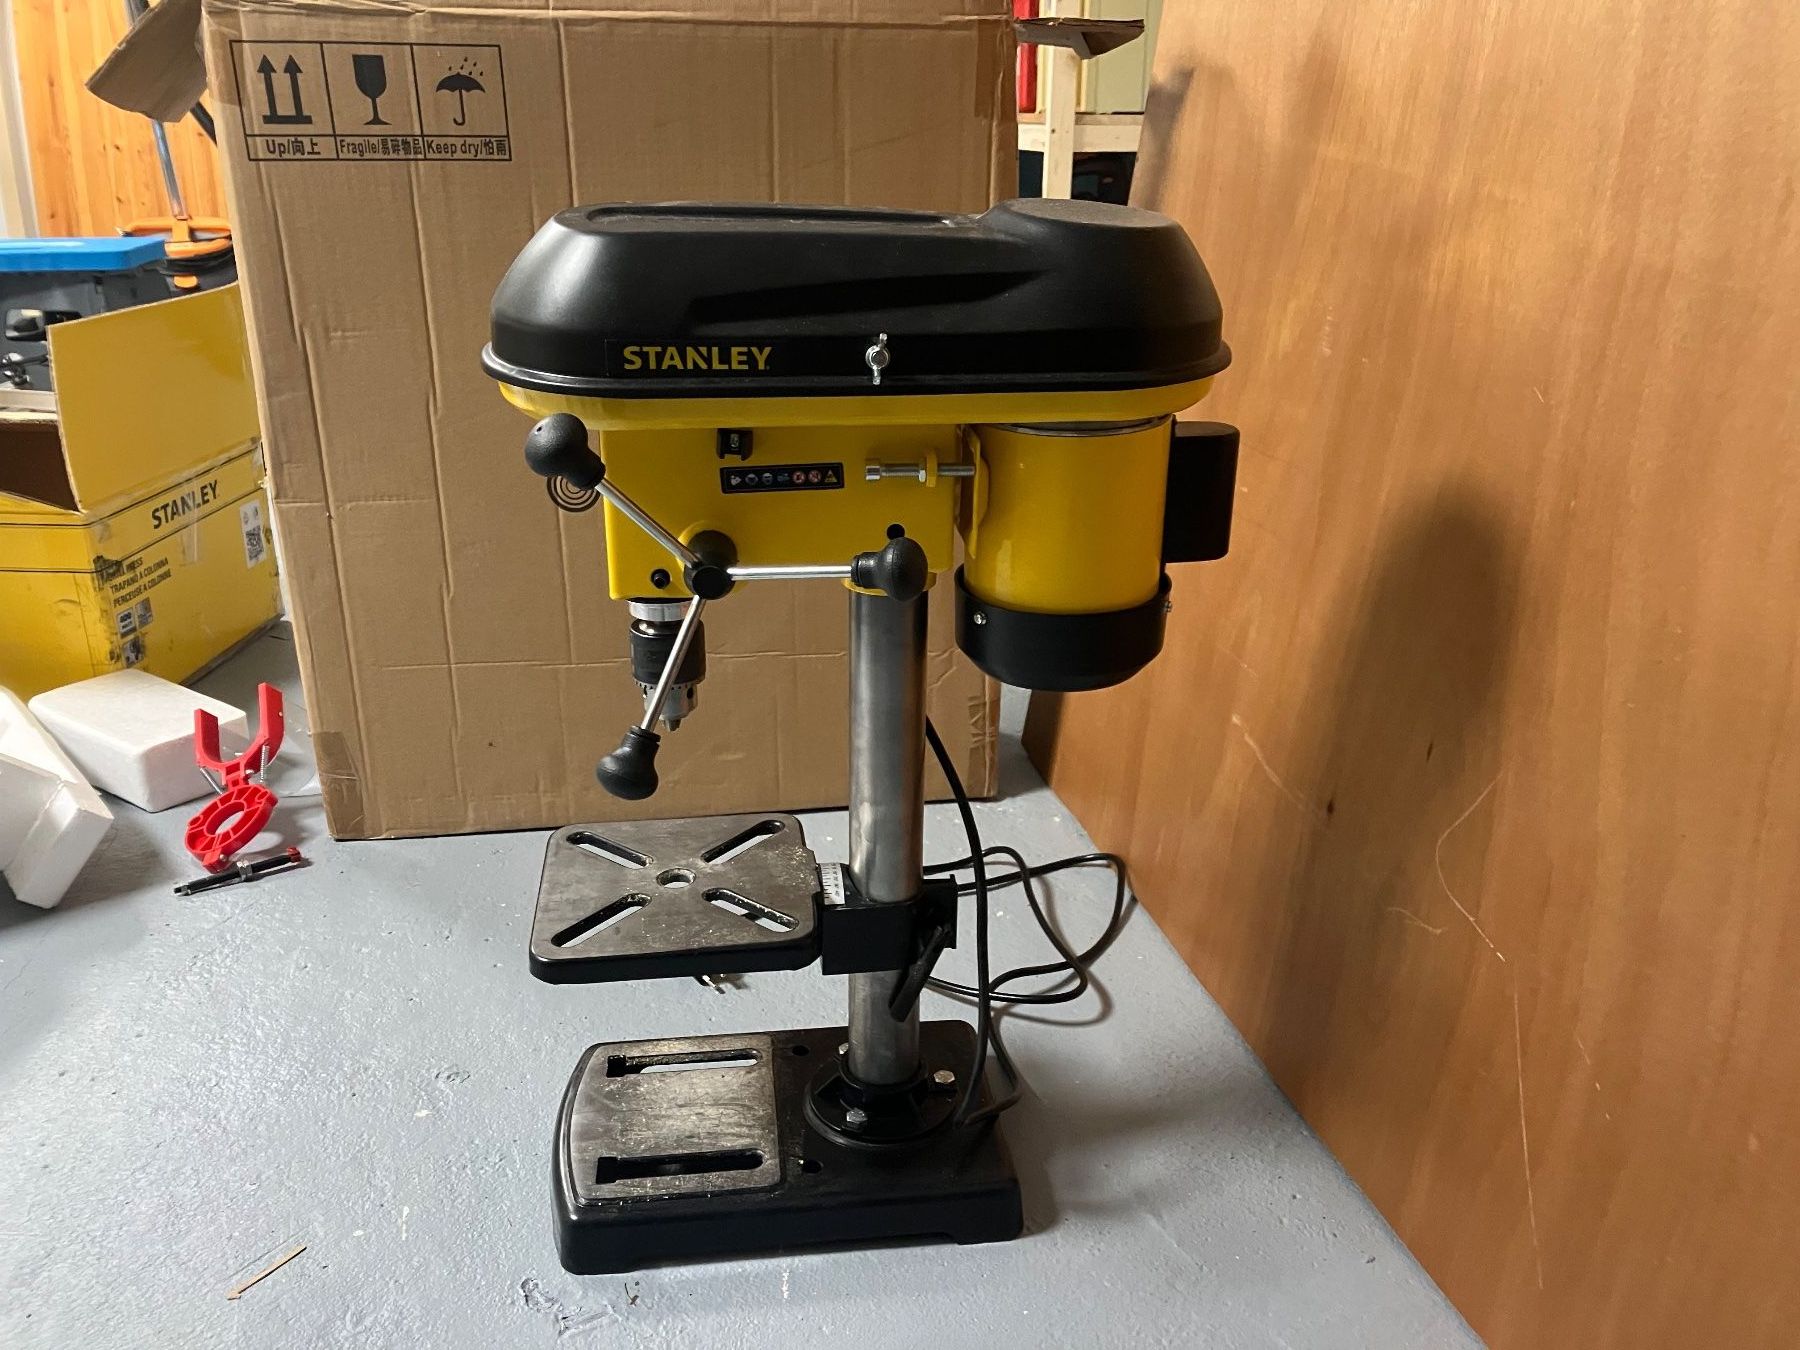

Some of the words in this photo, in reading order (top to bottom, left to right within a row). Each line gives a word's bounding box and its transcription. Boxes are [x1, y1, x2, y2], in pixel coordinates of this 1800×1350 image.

[265, 138, 321, 157] Up/向上
[426, 139, 457, 157] Keep
[623, 345, 772, 370] STANLEY
[151, 480, 218, 529] STANLEY
